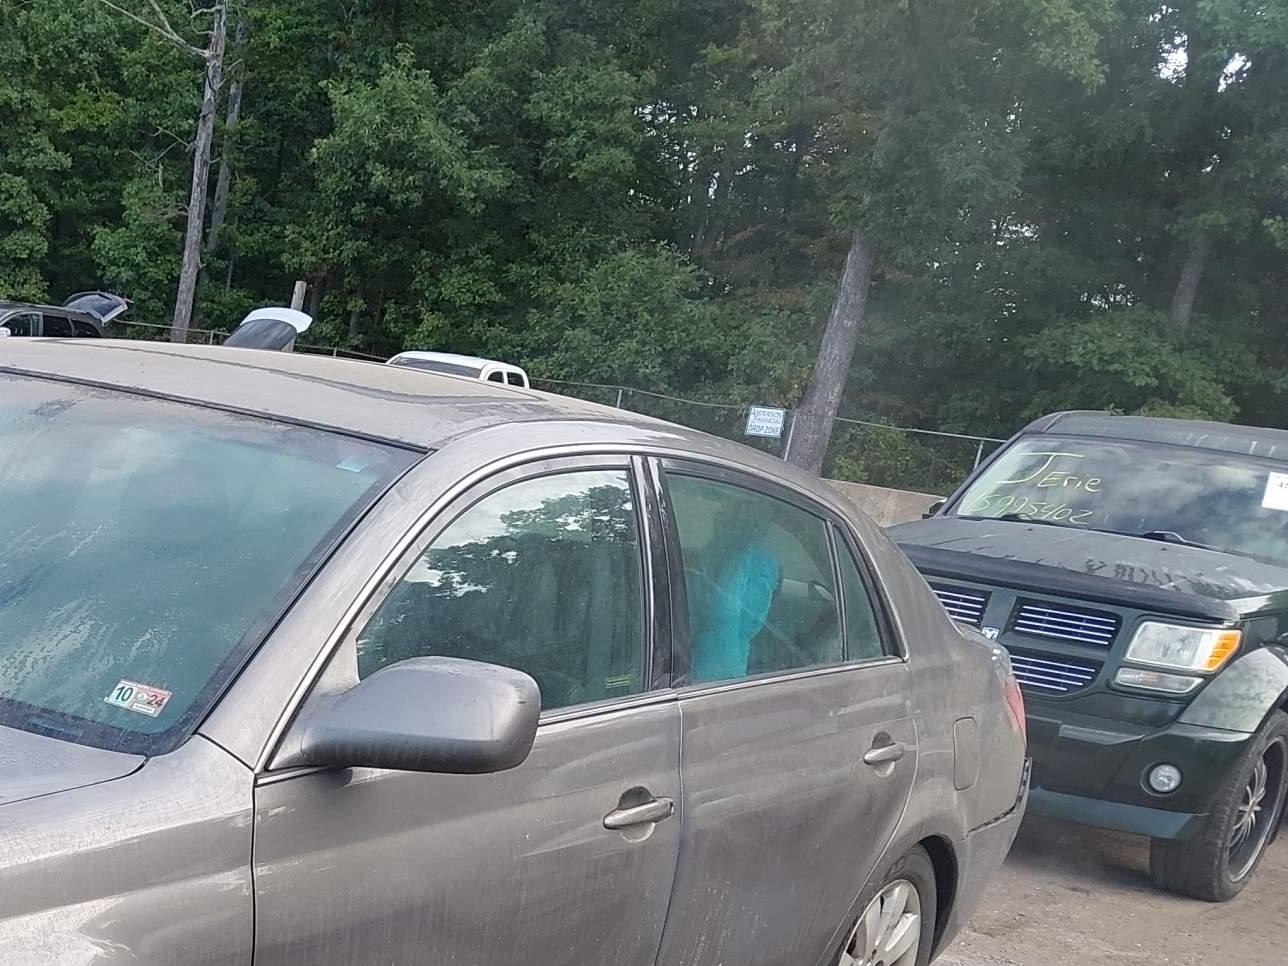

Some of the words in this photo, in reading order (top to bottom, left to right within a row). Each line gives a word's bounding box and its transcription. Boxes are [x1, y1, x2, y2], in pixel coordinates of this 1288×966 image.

[748, 424, 764, 432] DROP
[764, 424, 779, 433] ZONE
[116, 686, 134, 702] 10
[147, 694, 165, 708] 24
